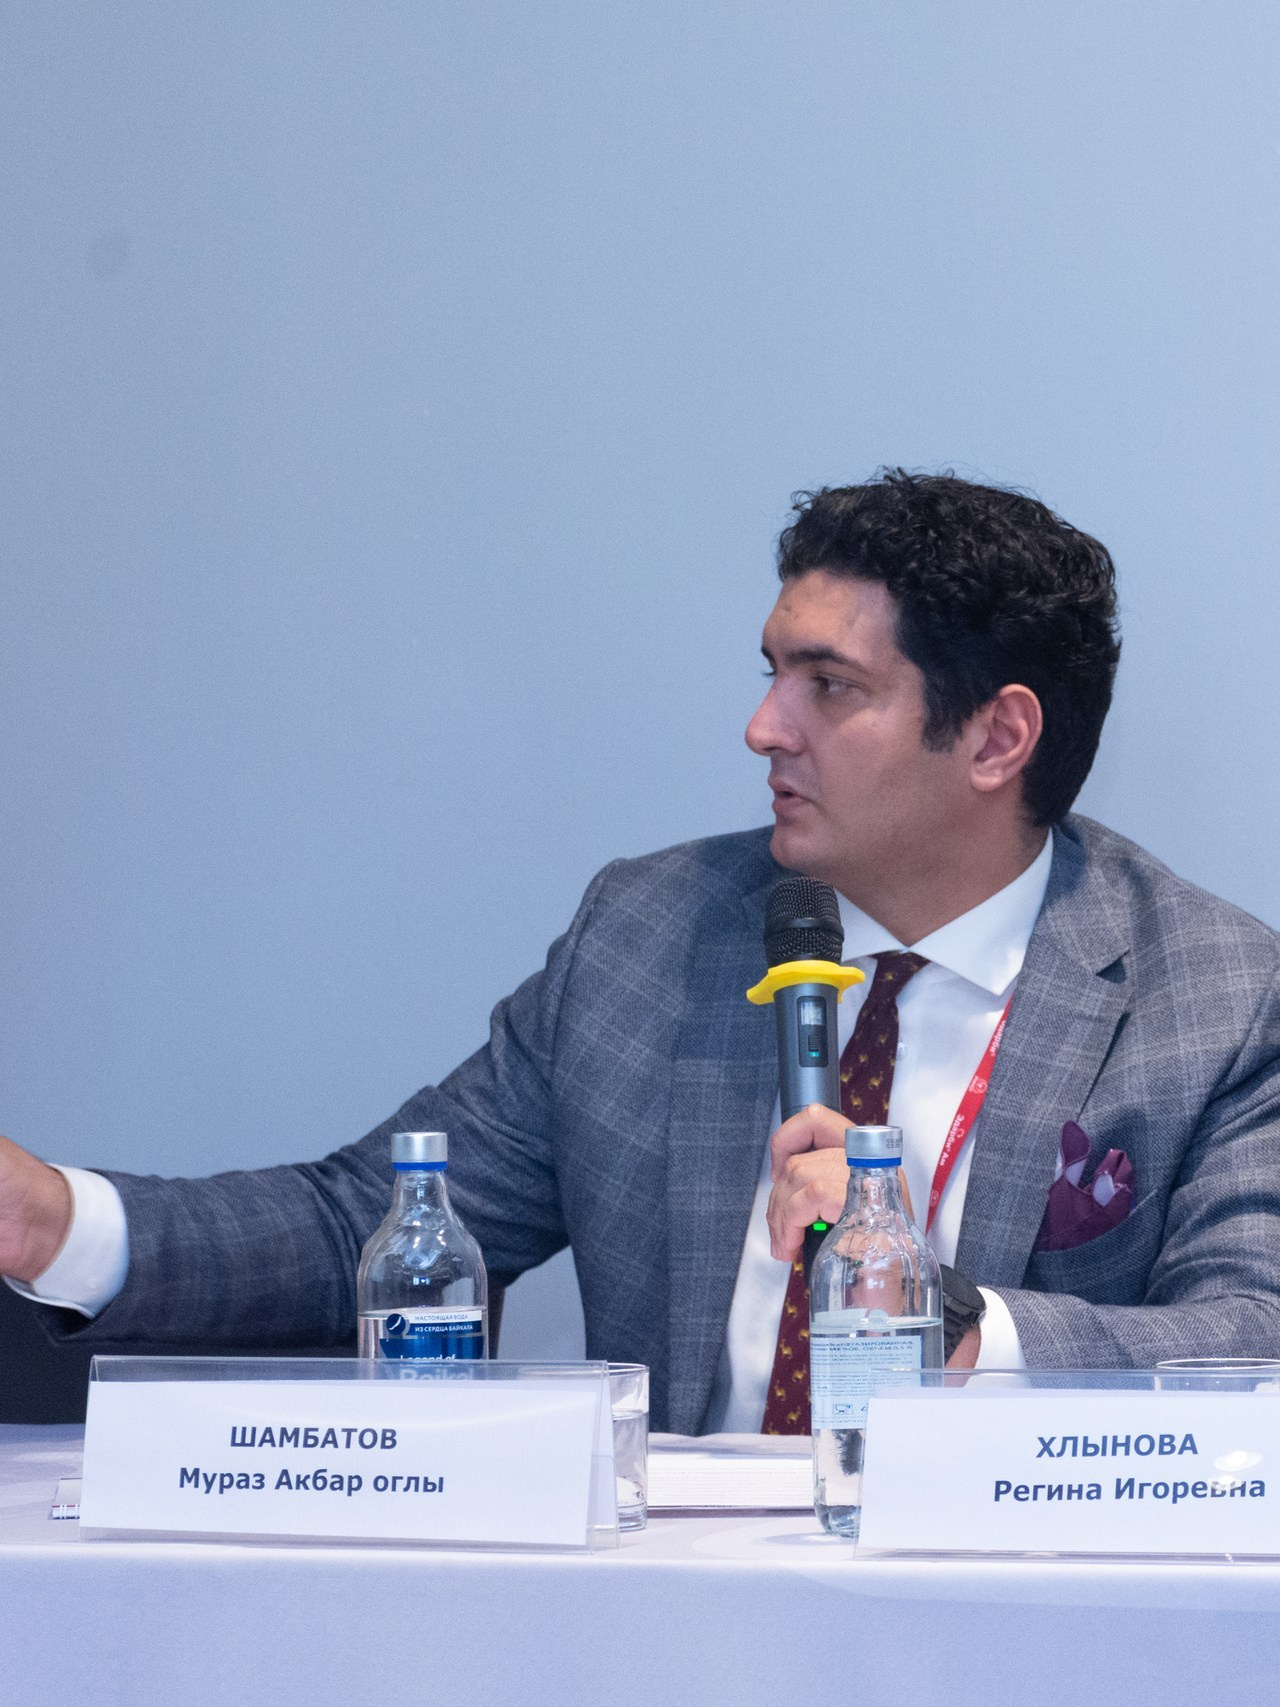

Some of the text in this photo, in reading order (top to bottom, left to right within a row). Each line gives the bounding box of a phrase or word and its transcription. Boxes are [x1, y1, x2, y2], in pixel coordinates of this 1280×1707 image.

[230, 1426, 397, 1449] ШАМБАТОВ
[1036, 1433, 1199, 1458] ХЛЫНОВА
[179, 1467, 444, 1496] Мураз Акбар оглы
[994, 1478, 1266, 1504] Регина Игоревна
